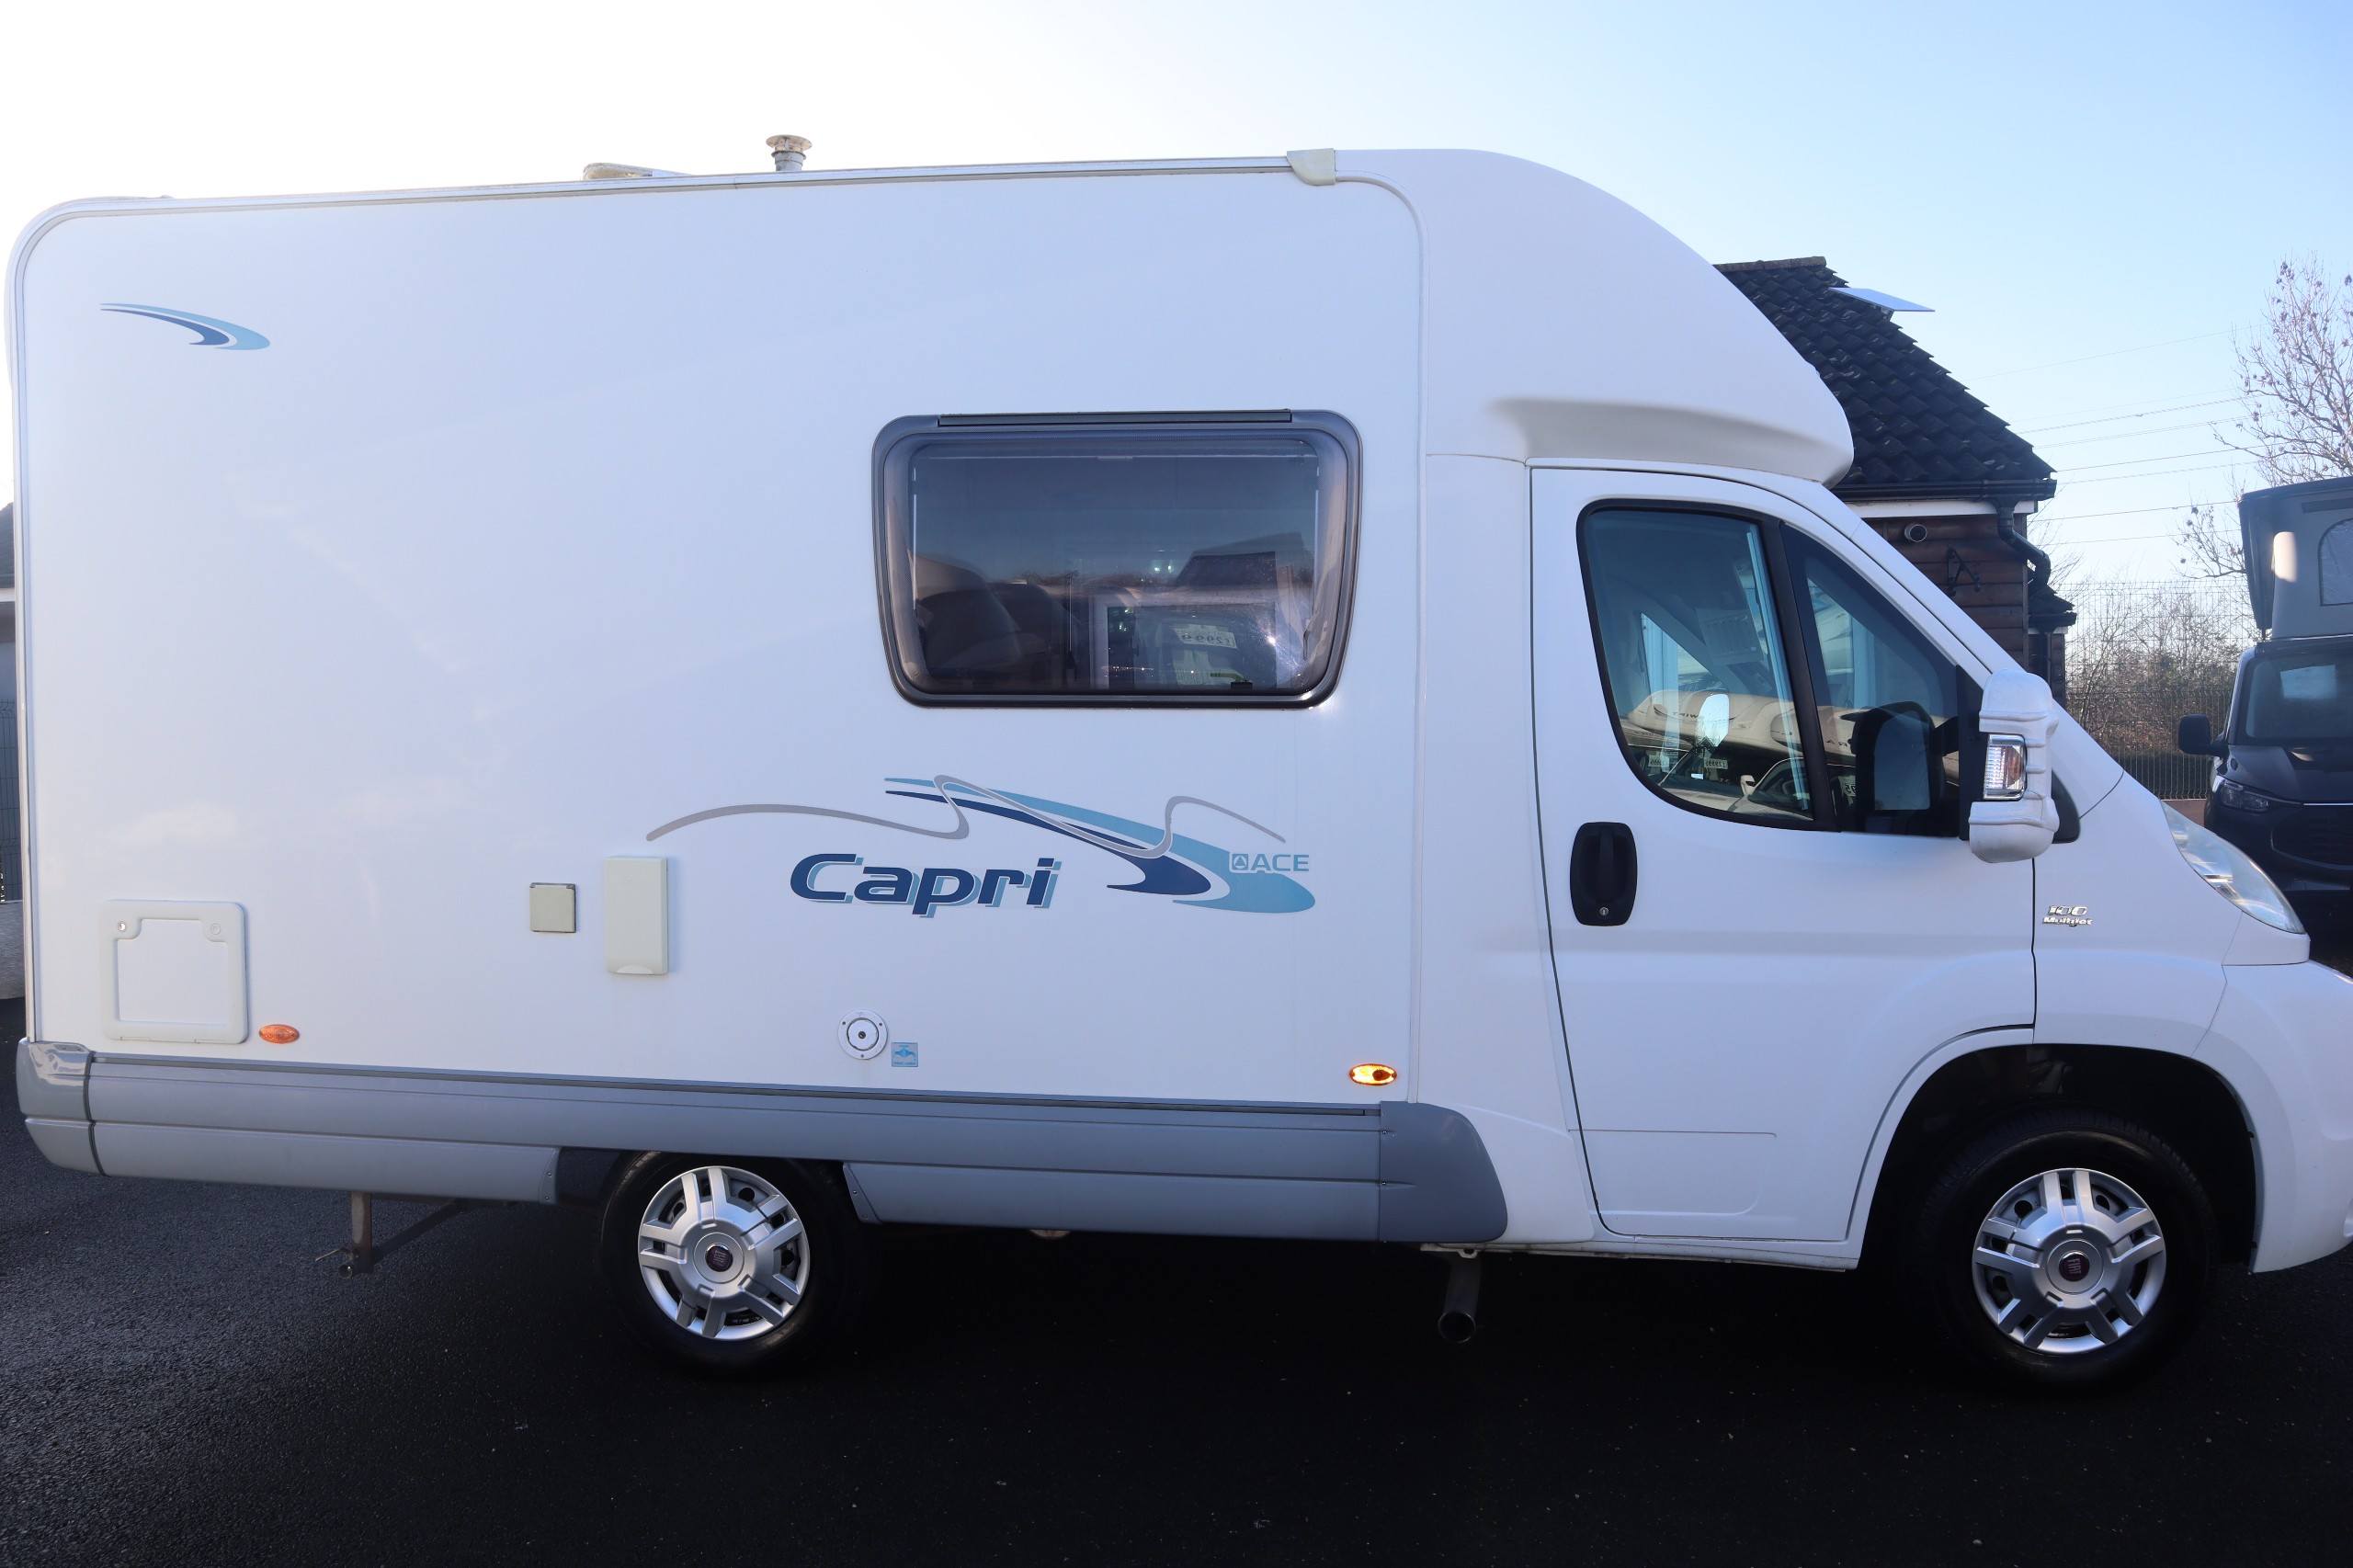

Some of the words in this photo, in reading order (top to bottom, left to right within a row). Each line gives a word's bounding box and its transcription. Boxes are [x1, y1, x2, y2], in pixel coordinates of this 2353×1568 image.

[1251, 853, 1310, 872] ACE
[790, 853, 1063, 918] Capri
[2066, 1258, 2082, 1275] FIAT
